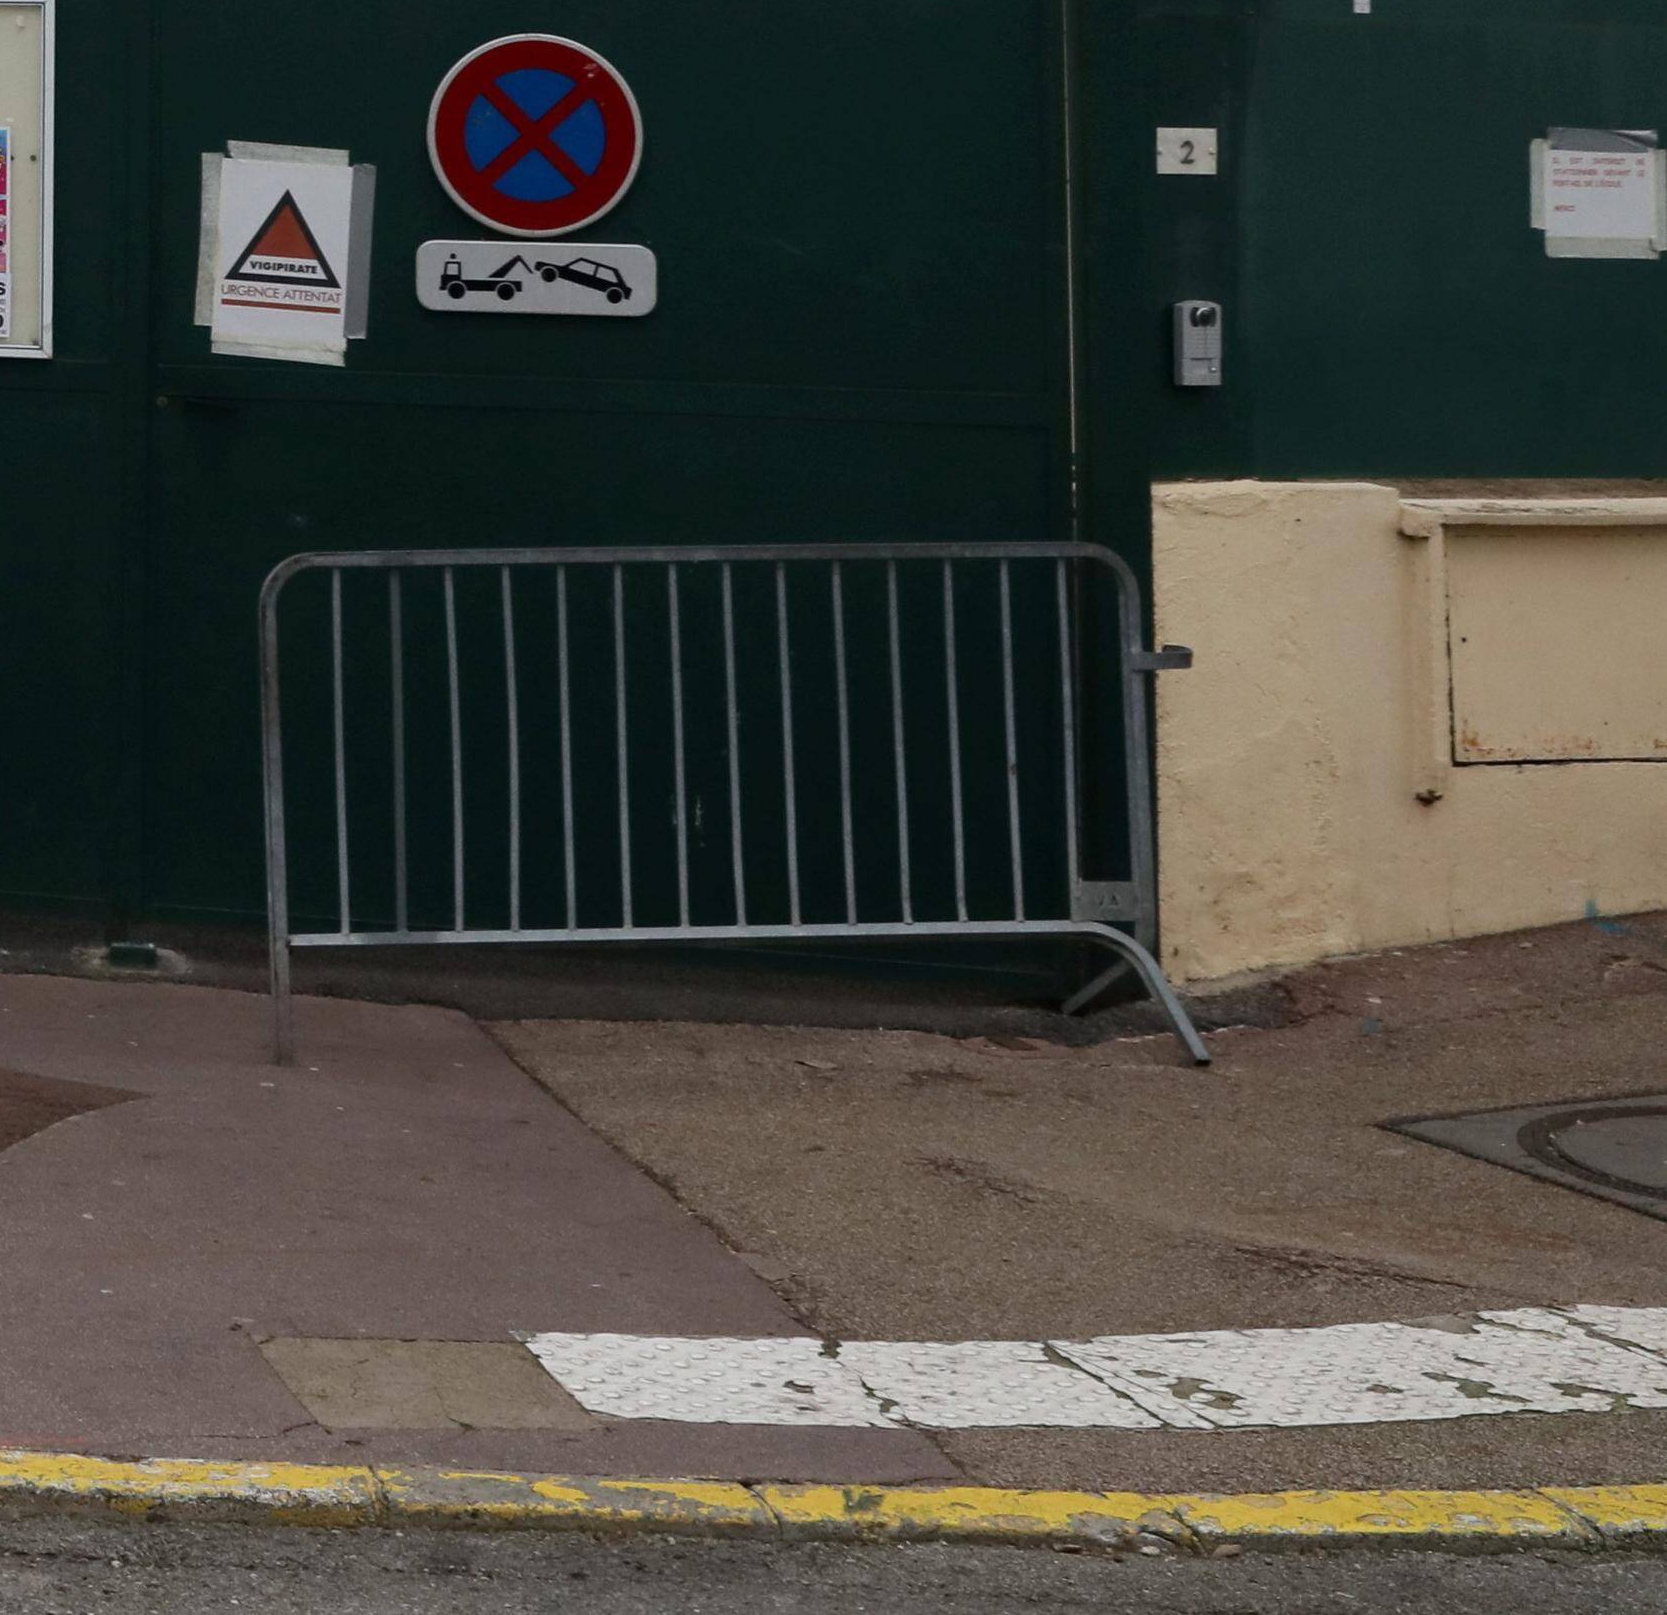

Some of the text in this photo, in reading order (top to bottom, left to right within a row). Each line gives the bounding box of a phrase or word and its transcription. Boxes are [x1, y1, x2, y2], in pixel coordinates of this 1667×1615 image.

[1179, 139, 1196, 165] 2
[249, 260, 319, 274] VIGIPIRATE
[221, 284, 342, 304] URGENCE ATTENTAT
